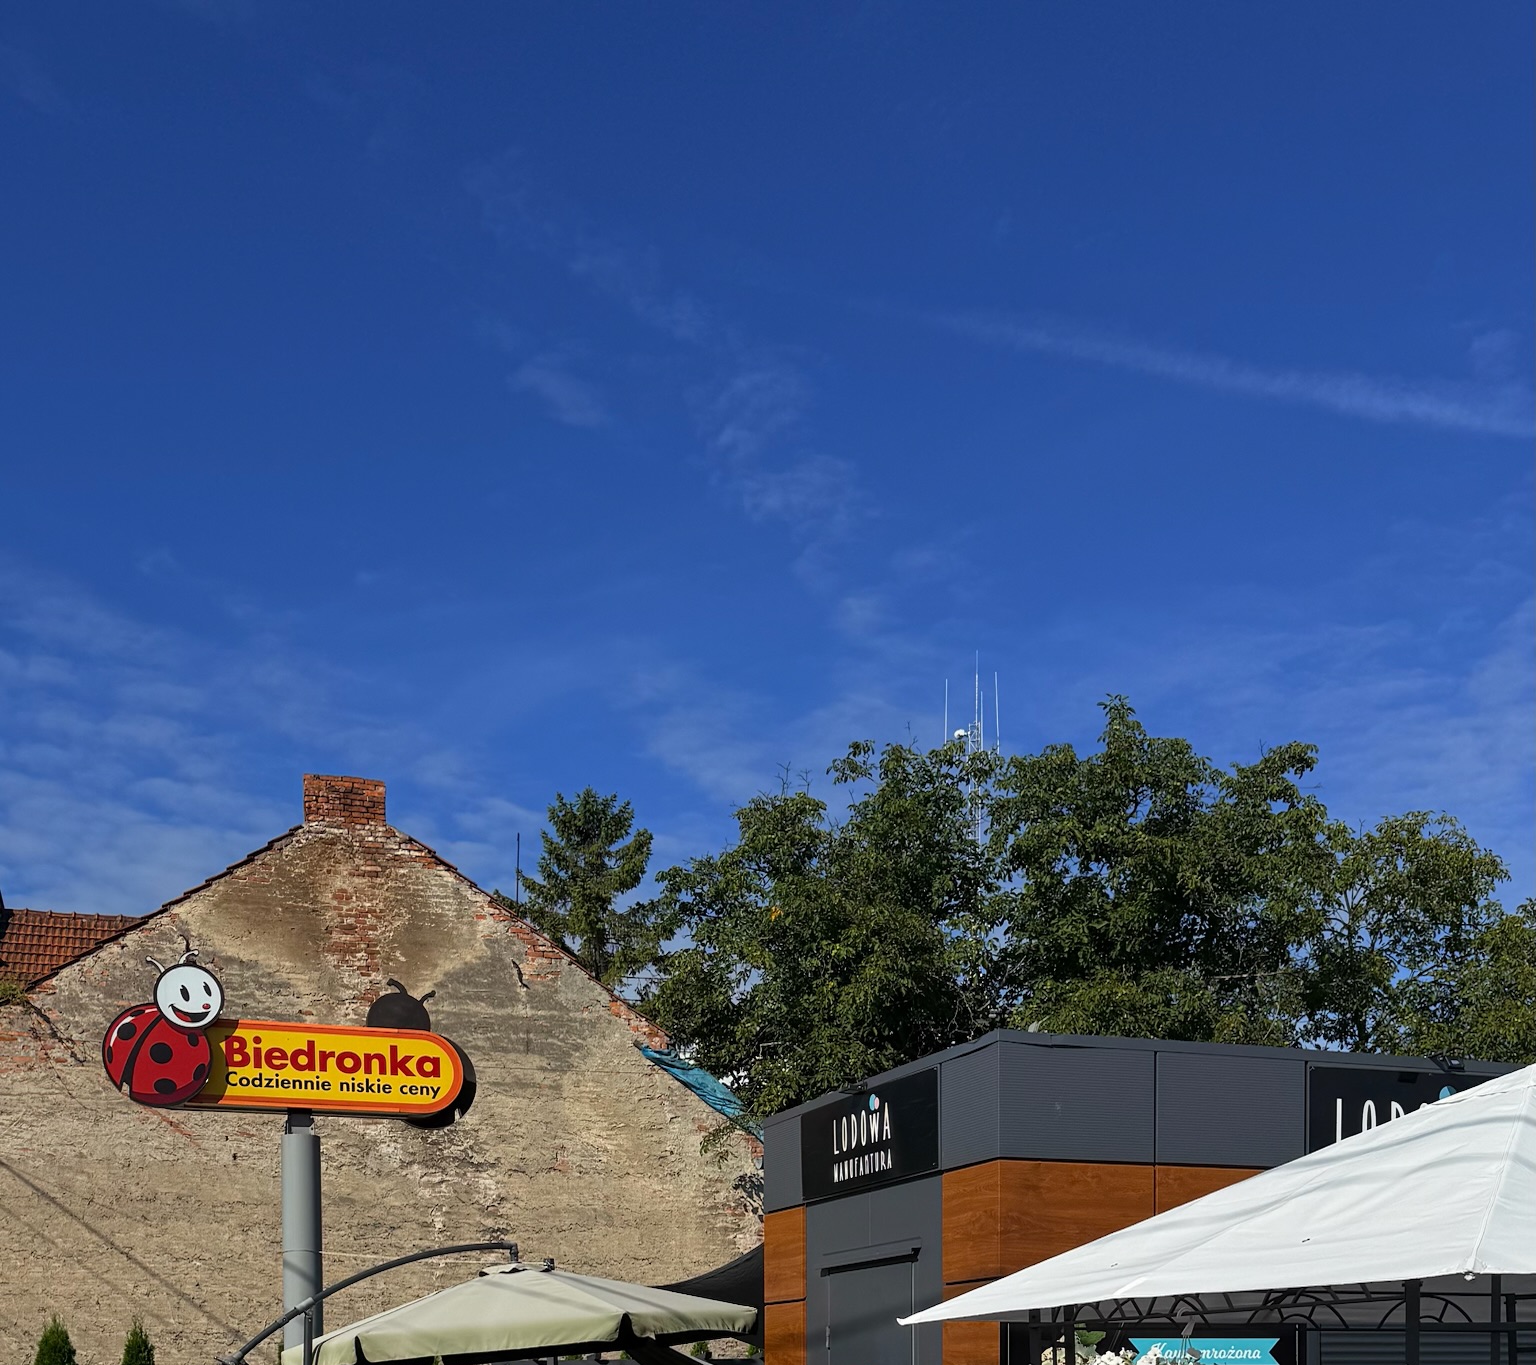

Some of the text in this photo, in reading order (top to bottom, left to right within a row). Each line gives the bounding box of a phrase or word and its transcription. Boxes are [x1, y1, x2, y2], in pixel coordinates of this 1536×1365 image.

[224, 1035, 441, 1078] Biedronka
[225, 1071, 441, 1099] Codziennie niskie ceny
[833, 1102, 891, 1155] LODOWA
